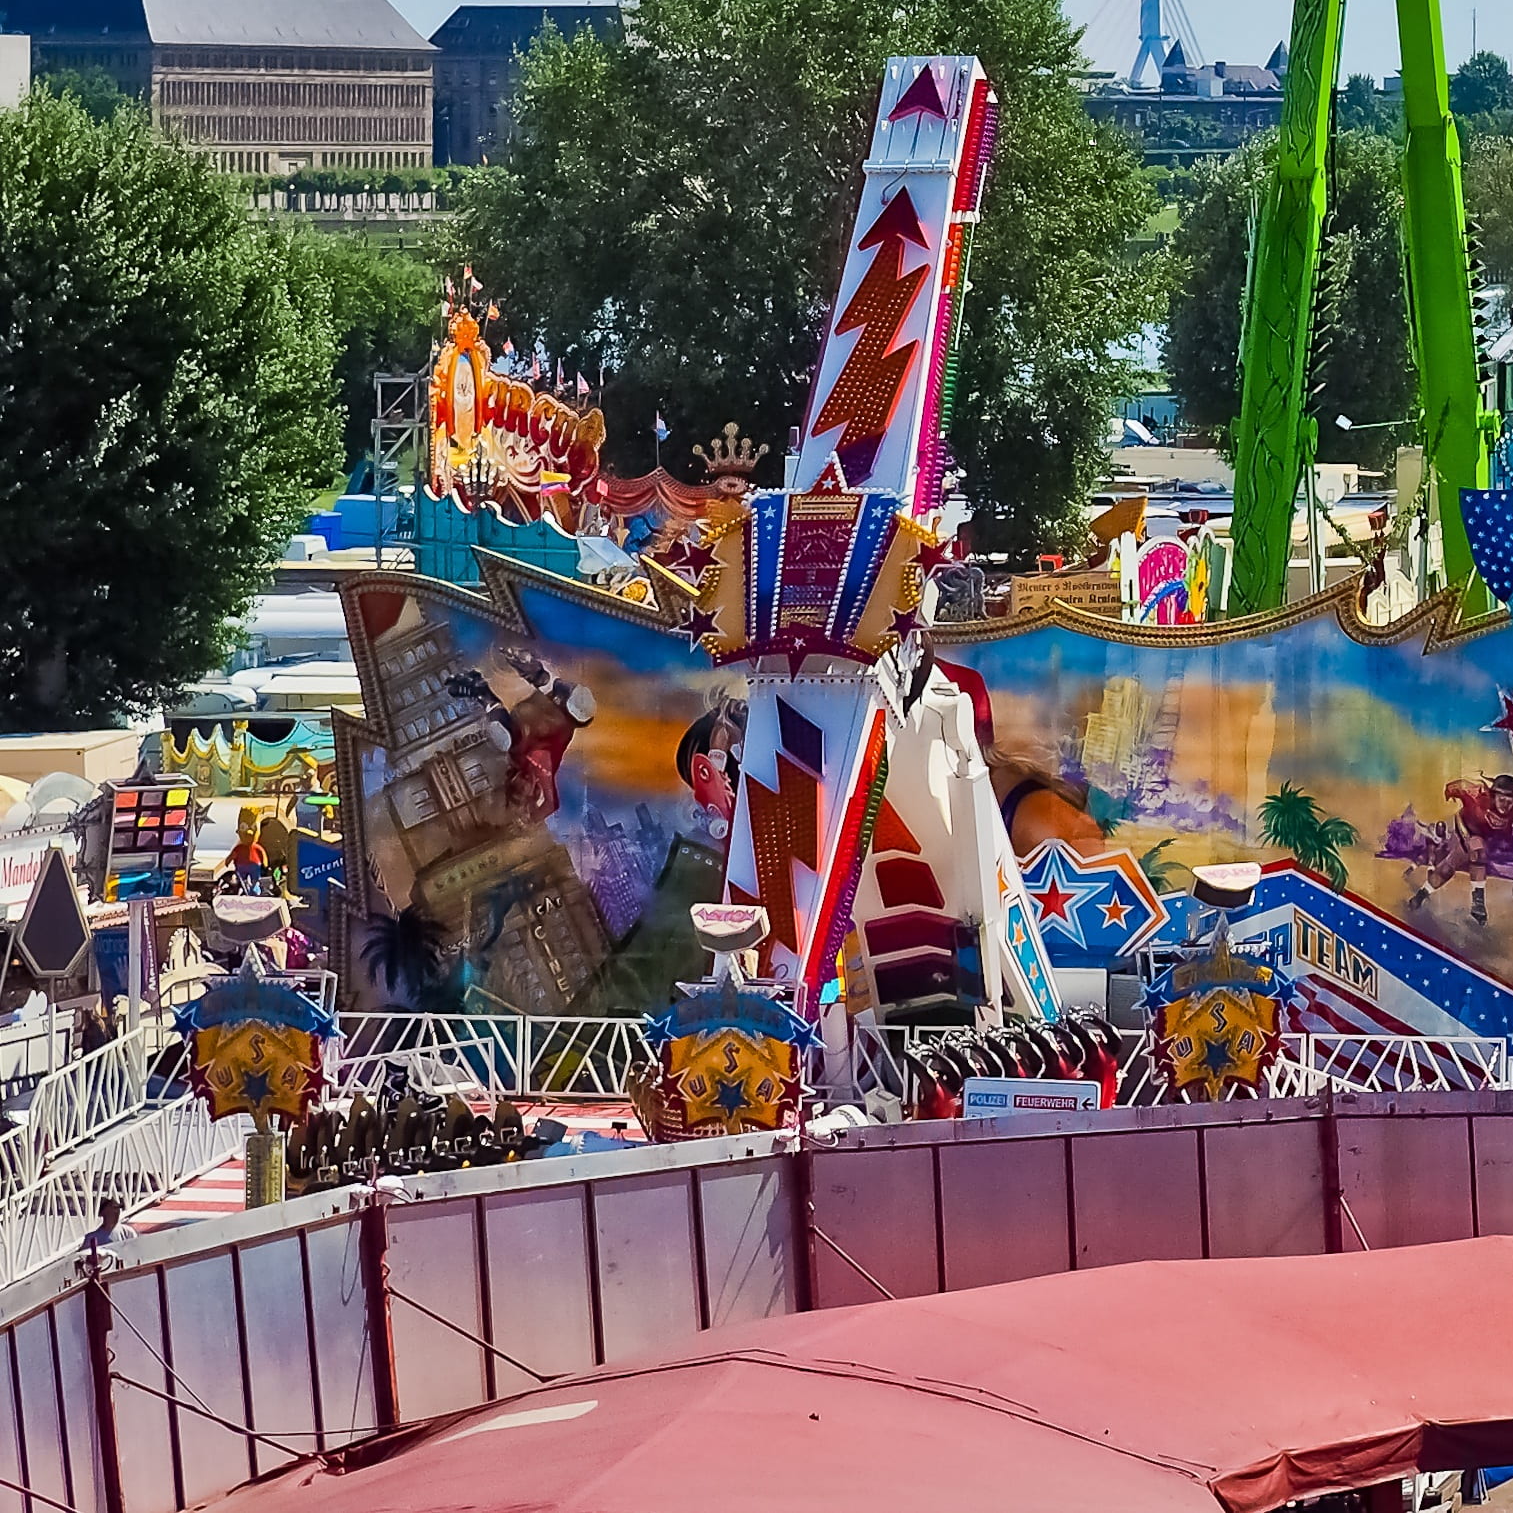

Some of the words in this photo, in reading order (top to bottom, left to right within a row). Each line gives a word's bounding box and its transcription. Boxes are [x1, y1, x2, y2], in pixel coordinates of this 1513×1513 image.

[1294, 909, 1378, 1000] TEAM
[969, 1093, 1007, 1106] POLIZEI
[1015, 1096, 1075, 1109] FEUERWEHR
